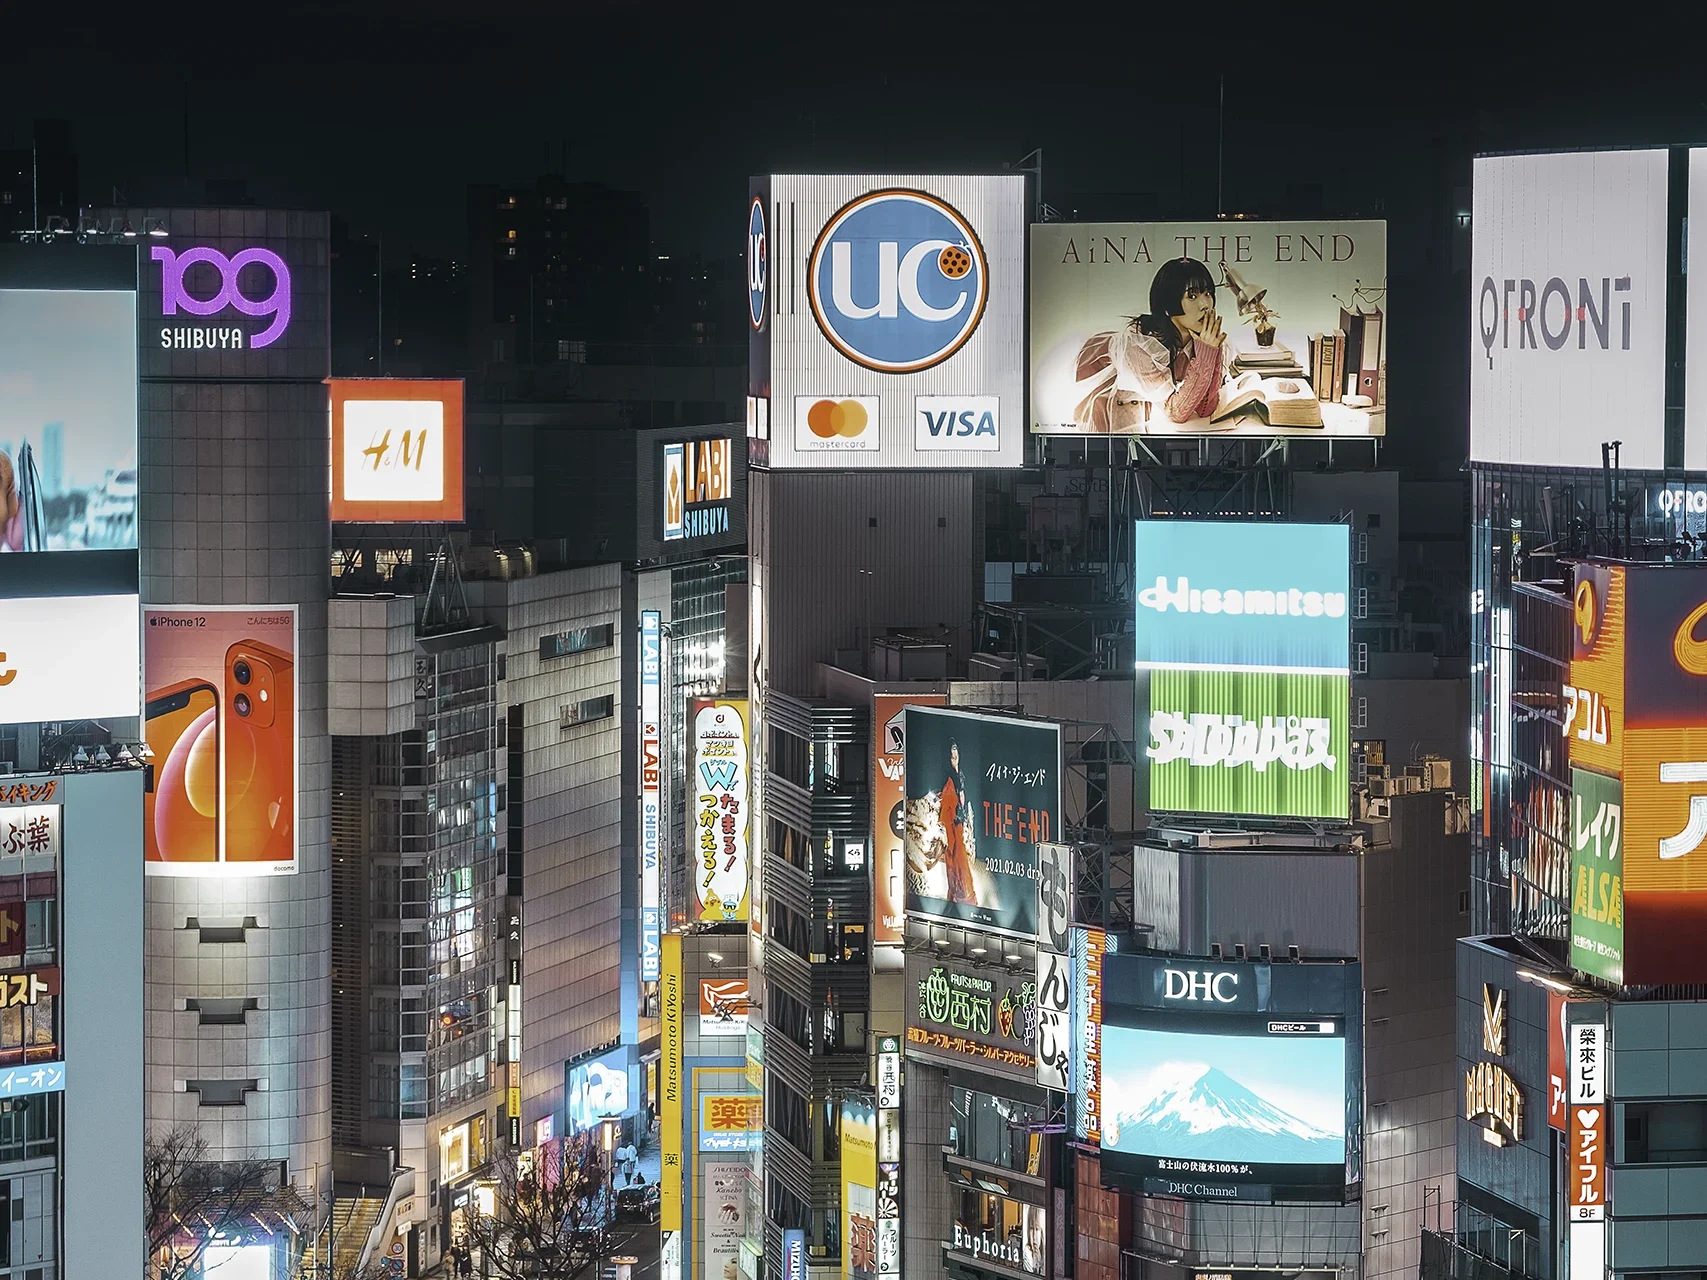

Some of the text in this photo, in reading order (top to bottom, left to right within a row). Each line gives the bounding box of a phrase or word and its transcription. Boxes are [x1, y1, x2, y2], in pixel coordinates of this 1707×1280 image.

[1061, 235, 1355, 264] AiNA THE END
[151, 246, 292, 348] 109
[161, 328, 243, 349] SHIBUYA
[919, 409, 997, 438] VISA
[361, 428, 428, 472] H&M
[809, 439, 866, 449] mastercard
[685, 439, 732, 504] LABI
[684, 506, 729, 539] SHIBUYA
[1138, 577, 1345, 617] Hisamitsu
[157, 616, 206, 628] iPhone 12
[644, 635, 659, 682] LABI
[1562, 684, 1608, 744] アコム
[644, 740, 658, 791] LABI
[645, 804, 656, 869] SHIBUYA
[983, 801, 1049, 843] THE END
[1576, 794, 1621, 860] レイク
[985, 857, 1025, 877] 2021.02.03
[1574, 865, 1621, 928] ALSA
[644, 932, 658, 972] LABI
[1164, 969, 1238, 1002] DHC
[951, 989, 992, 1035] 西村
[2, 1067, 62, 1092] イーオン
[667, 1024, 677, 1102] Matsumoto
[711, 1098, 747, 1129] 薬
[1466, 1062, 1524, 1142] MAGNET
[664, 1153, 678, 1166] 薬
[1579, 1129, 1599, 1204] アイフル
[1168, 1182, 1237, 1197] DHC Channel
[1579, 1208, 1596, 1218] 8F
[954, 1225, 1020, 1262] Euphoria
